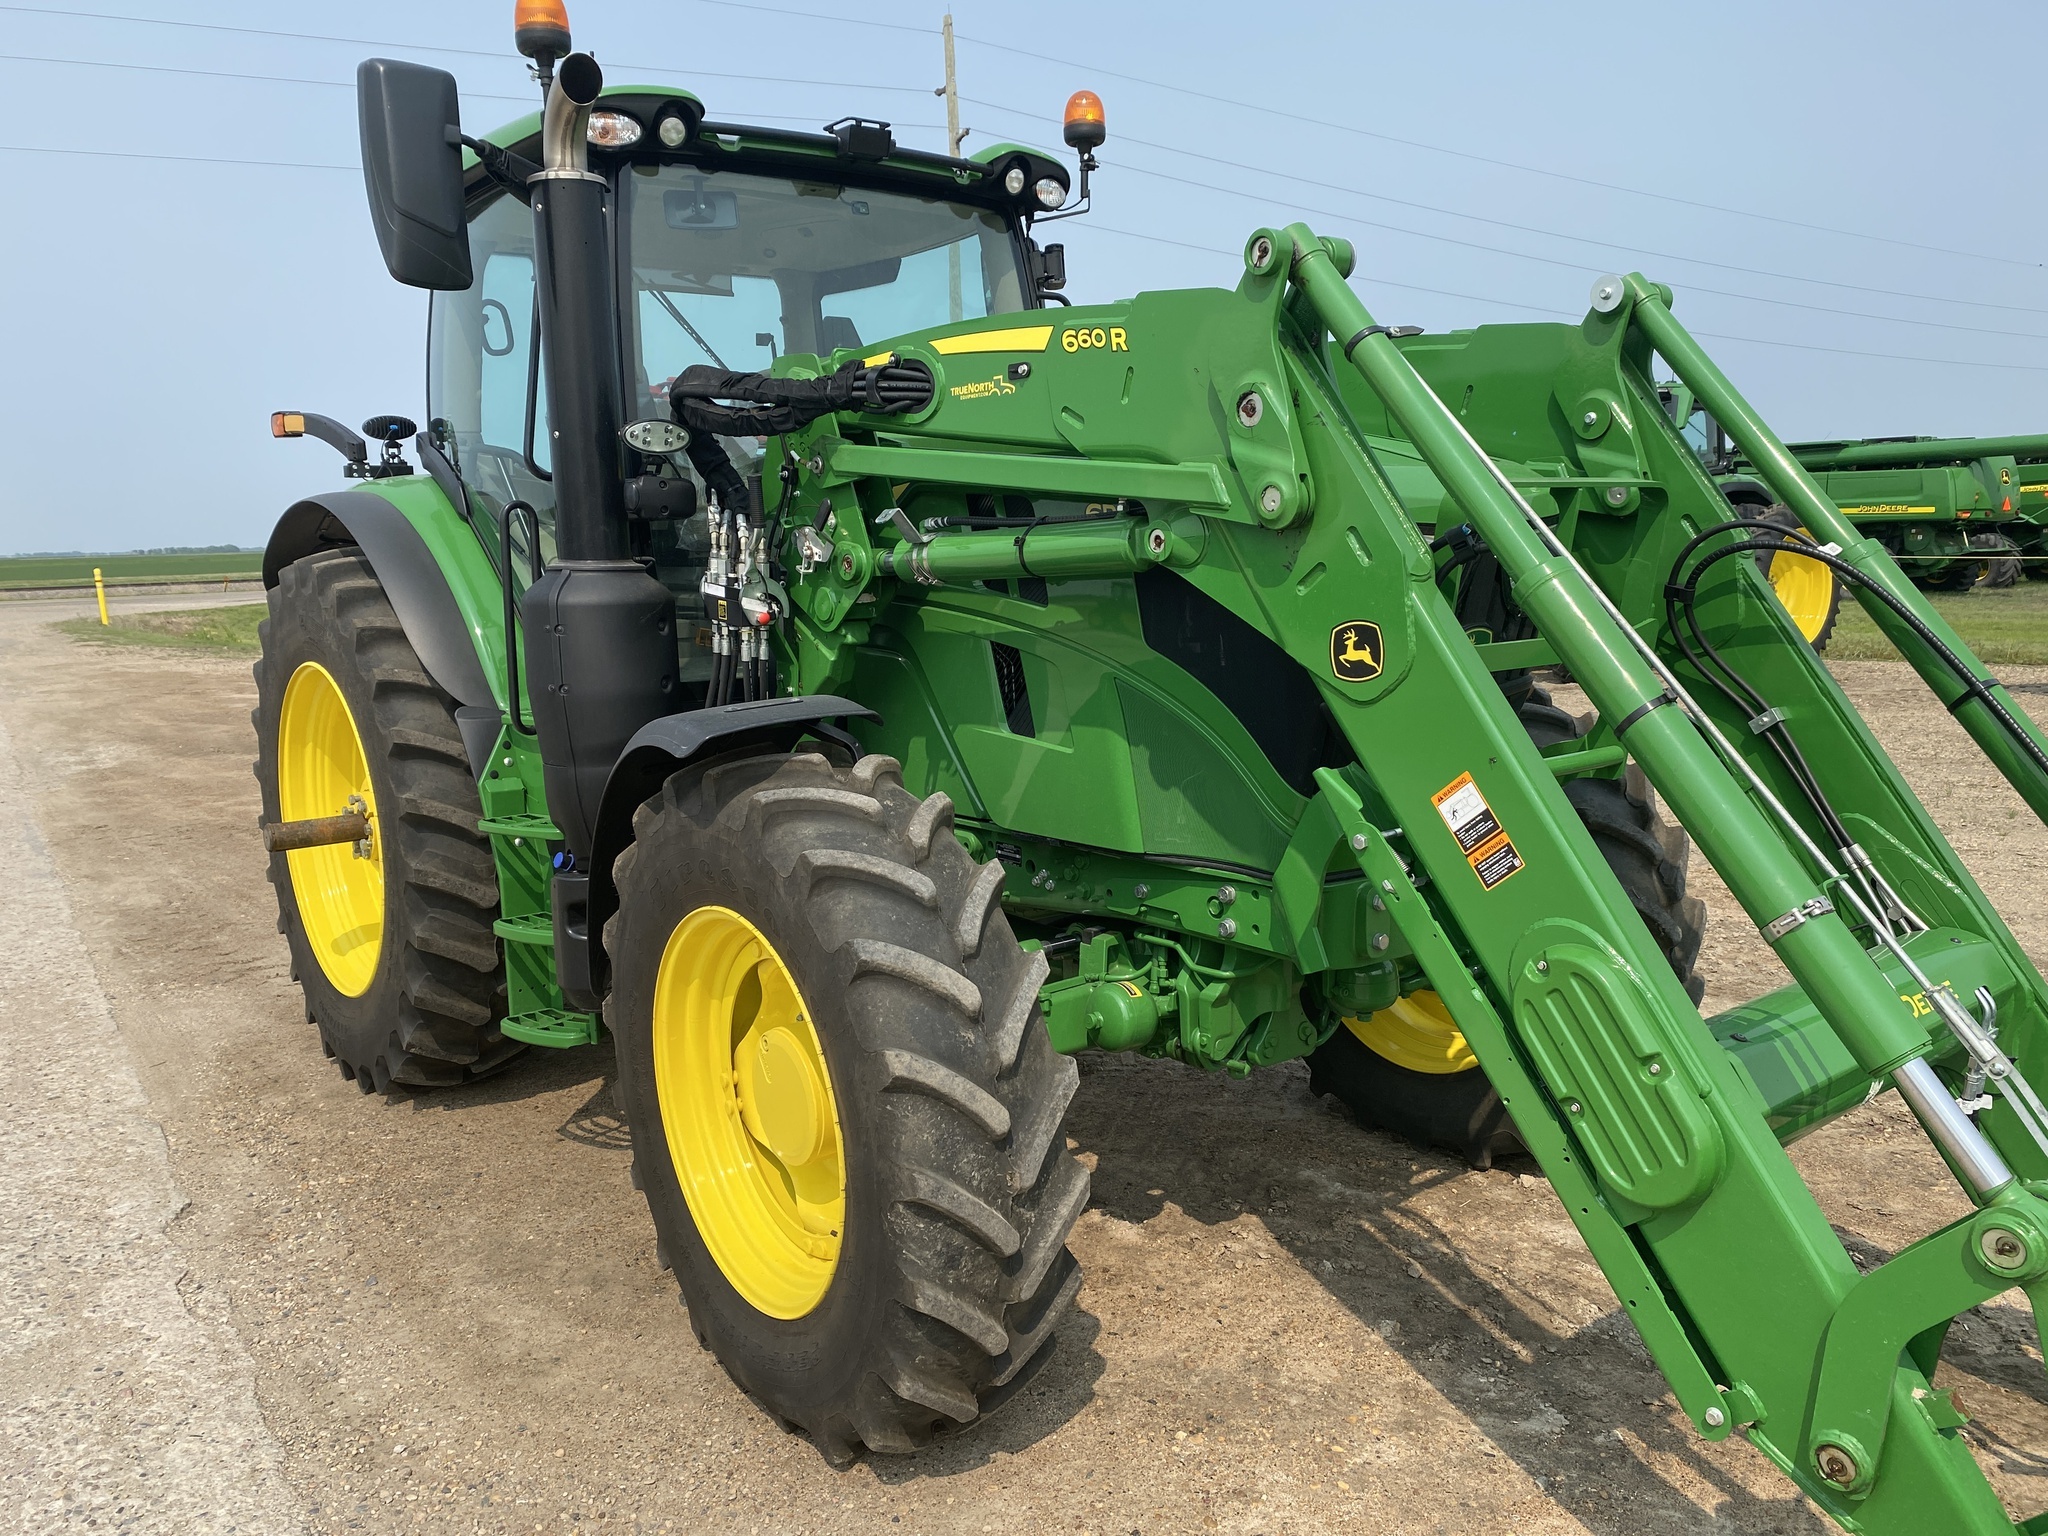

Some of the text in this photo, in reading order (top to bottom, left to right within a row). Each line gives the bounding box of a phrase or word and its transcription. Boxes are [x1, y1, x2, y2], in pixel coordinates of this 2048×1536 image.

[1858, 503, 1908, 512] JOHN DEERE
[1443, 777, 1467, 798] WARNING
[1479, 838, 1505, 858] WARNING
